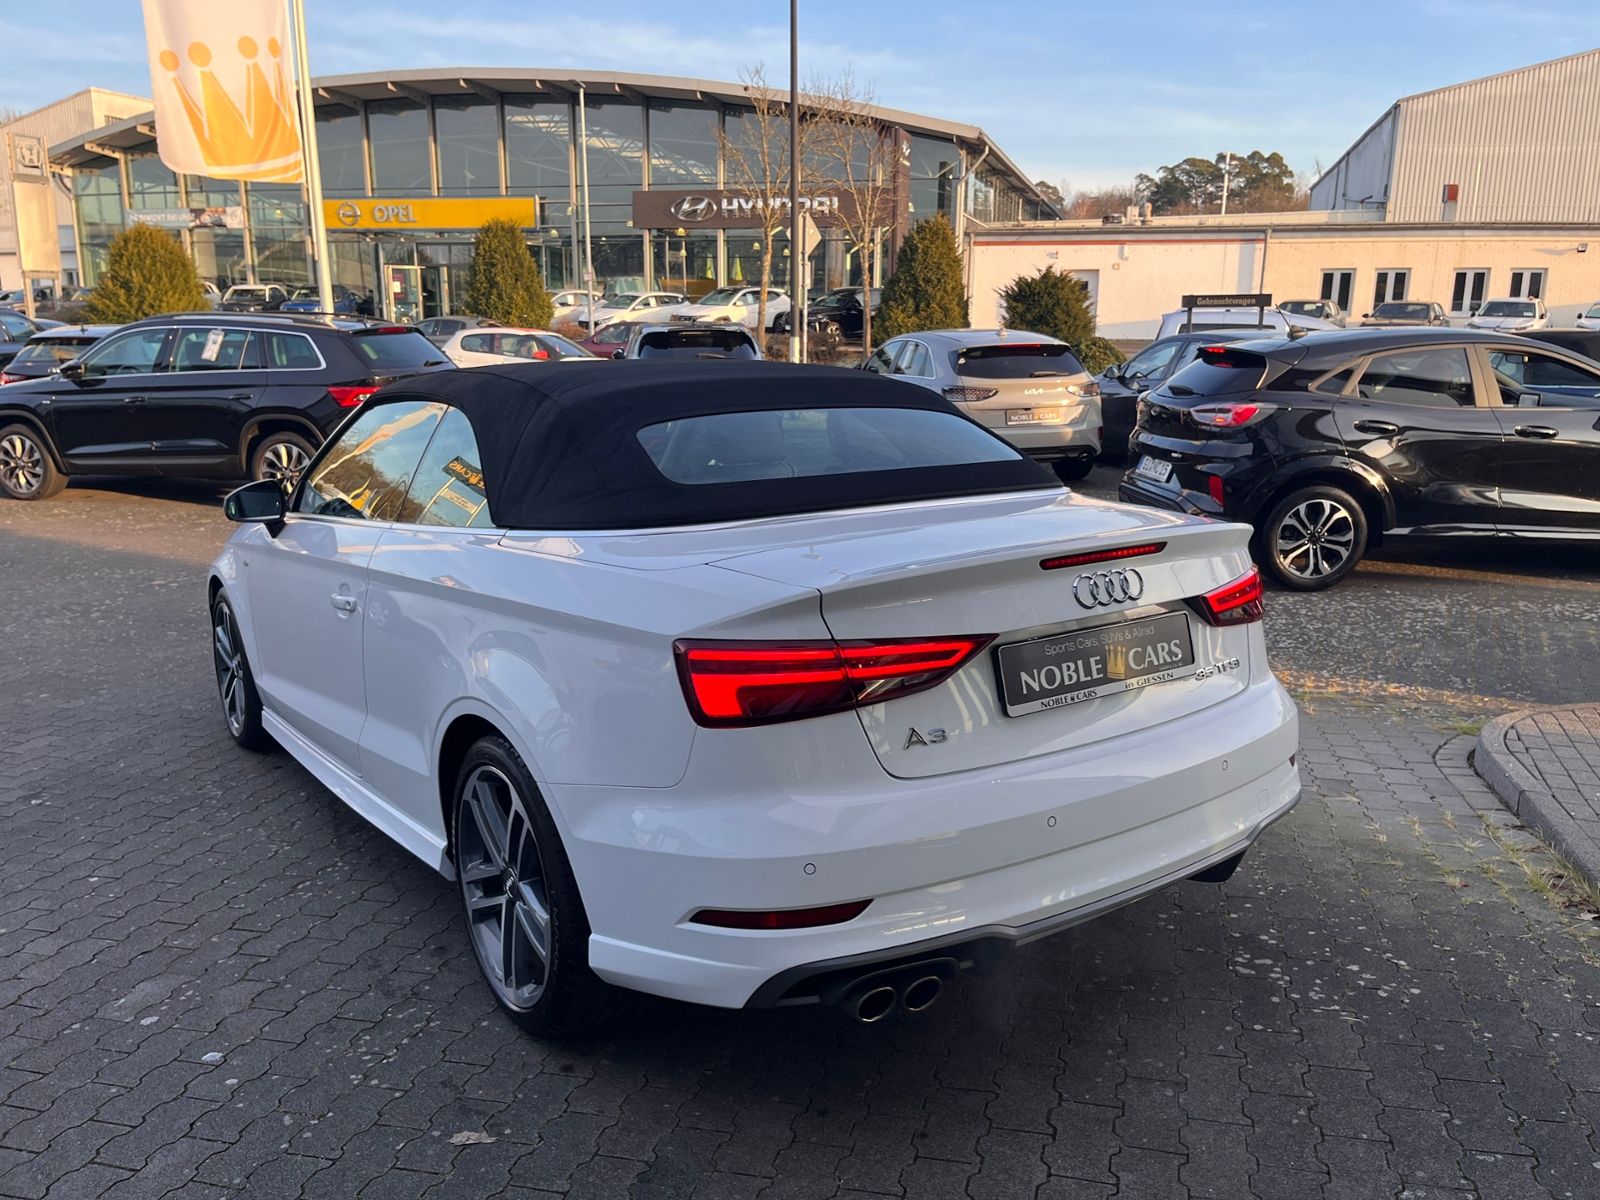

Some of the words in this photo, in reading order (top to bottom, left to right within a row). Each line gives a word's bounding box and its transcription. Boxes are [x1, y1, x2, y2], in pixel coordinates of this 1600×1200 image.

[373, 204, 416, 223] OPEL
[1196, 297, 1256, 306] Gebrauchtwagen
[1044, 642, 1076, 656] Sports
[1100, 630, 1123, 644] SUVs
[1125, 629, 1131, 640] &
[1019, 655, 1104, 695] NOBLE
[1127, 639, 1183, 670] CARS
[1195, 667, 1214, 681] 35
[1124, 681, 1135, 689] in
[1136, 672, 1174, 687] GIESSEN
[1040, 696, 1070, 709] NOBLE
[1076, 689, 1098, 702] CARS
[903, 727, 948, 750] A3
